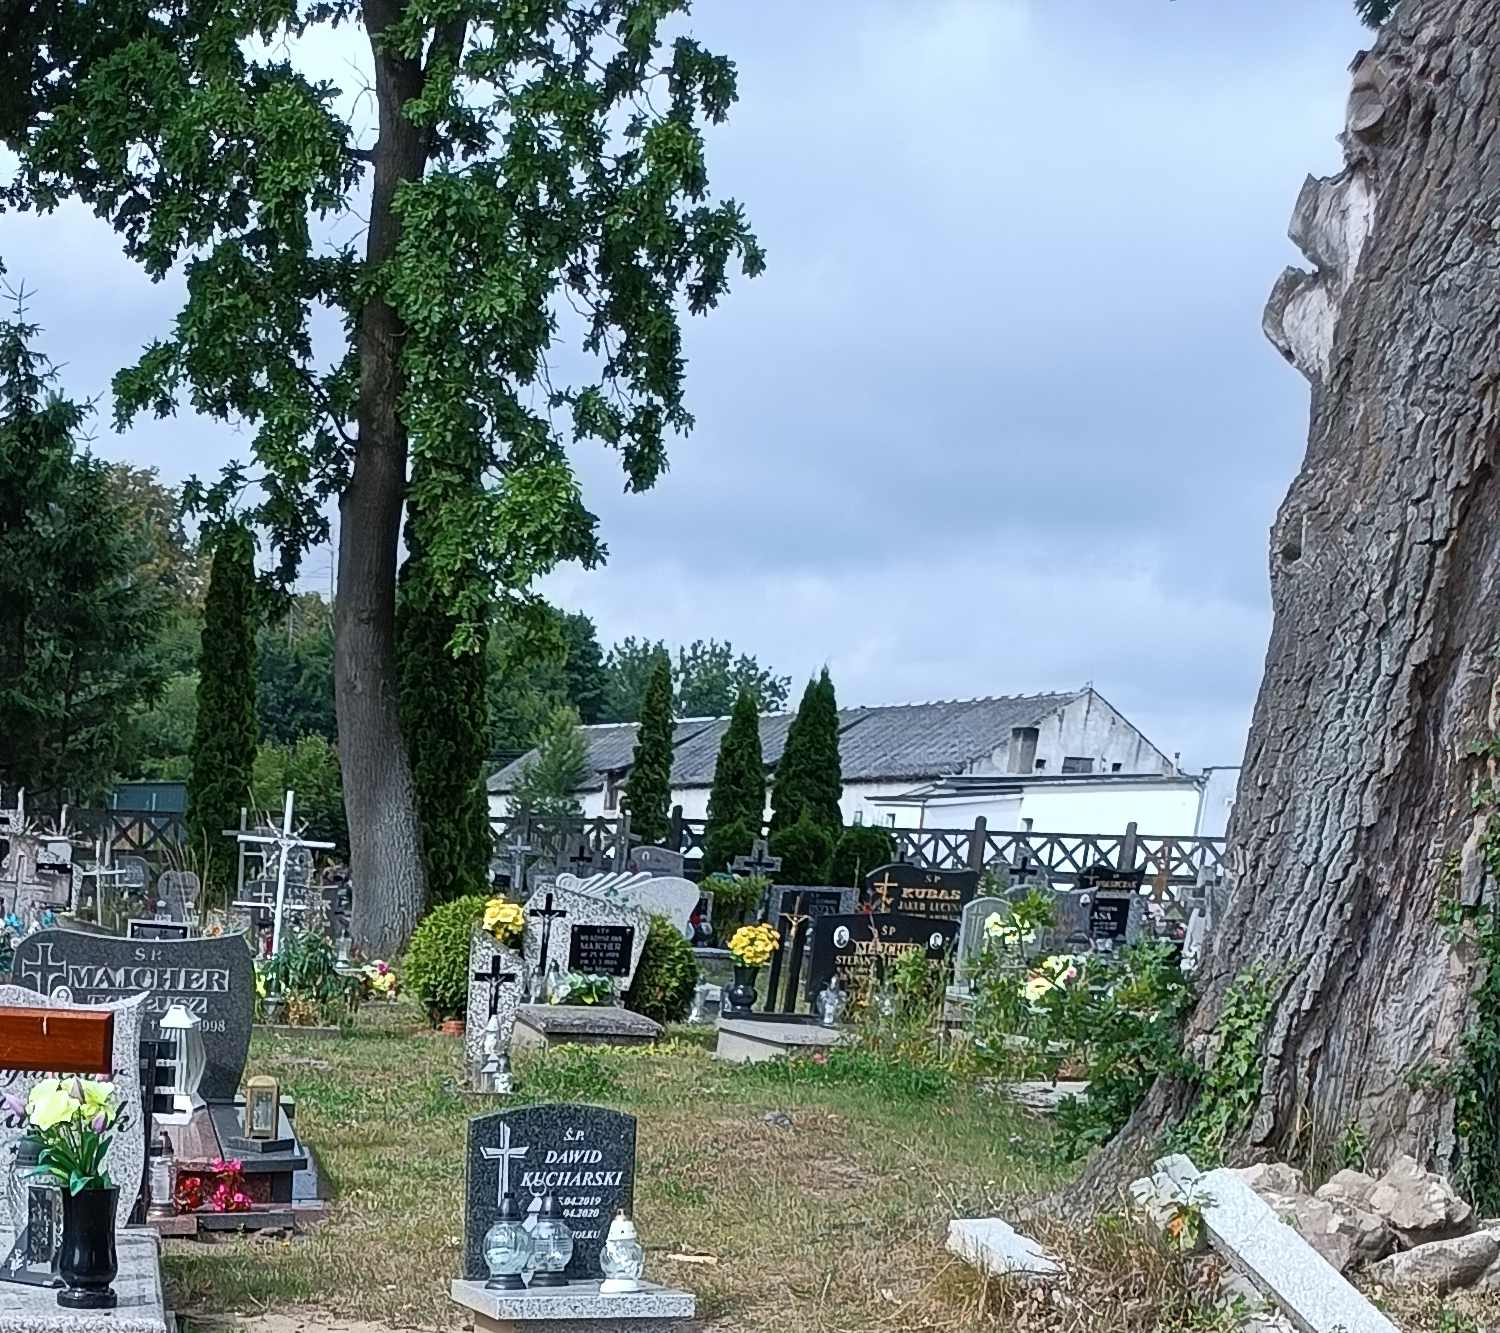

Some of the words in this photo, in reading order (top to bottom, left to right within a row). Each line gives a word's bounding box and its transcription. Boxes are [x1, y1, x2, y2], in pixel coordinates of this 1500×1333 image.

[67, 965, 229, 992] MAJCHER
[545, 1150, 603, 1164] DAWID
[520, 1171, 624, 1187] KUCHARSKI
